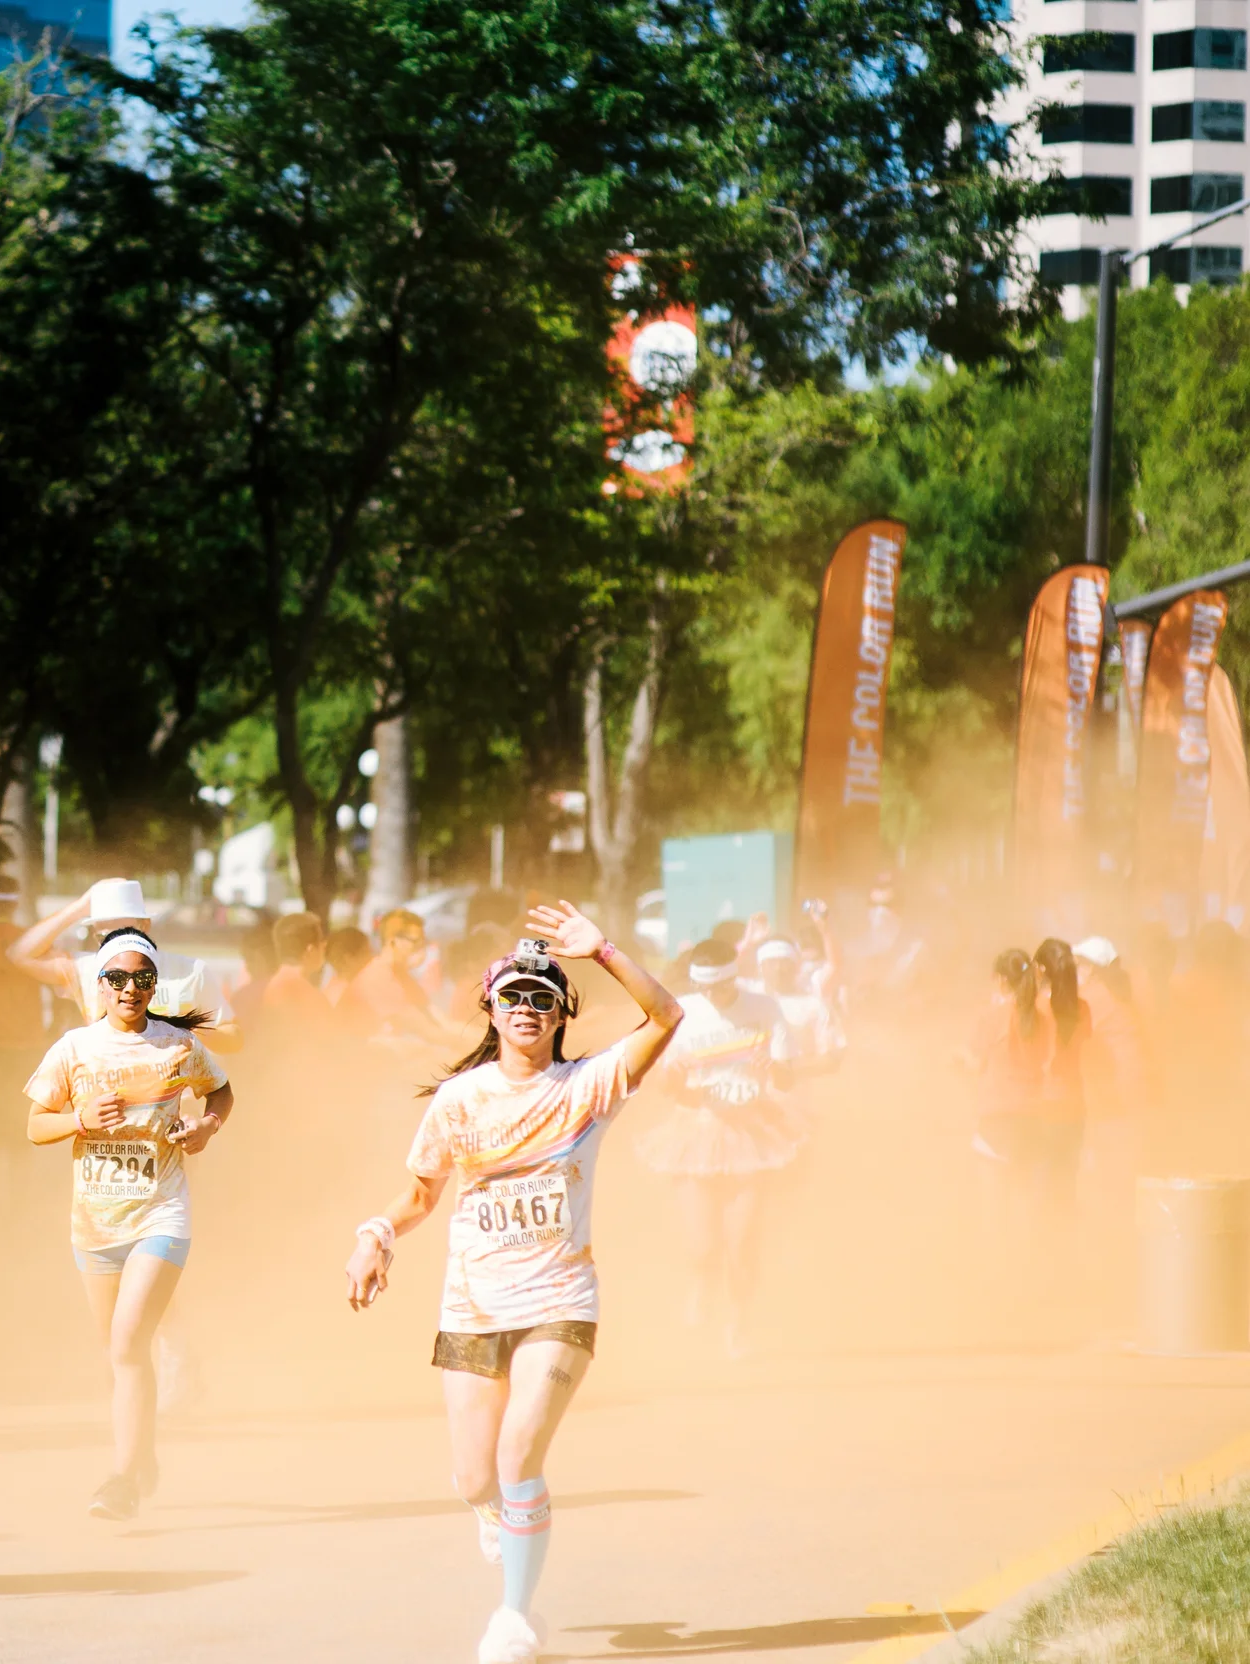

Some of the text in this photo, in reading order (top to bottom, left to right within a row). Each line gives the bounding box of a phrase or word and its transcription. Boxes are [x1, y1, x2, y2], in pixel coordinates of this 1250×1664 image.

[843, 533, 900, 807] THE COLOR RUN
[86, 1143, 144, 1155] THE COLOR RUN
[82, 1155, 155, 1185] 87294
[86, 1184, 143, 1196] THE COLOR RUN
[495, 1182, 526, 1198] COLOR
[527, 1179, 548, 1194] RUN
[478, 1192, 564, 1232] 80467
[502, 1231, 535, 1247] COLOR
[536, 1228, 557, 1242] RUN
